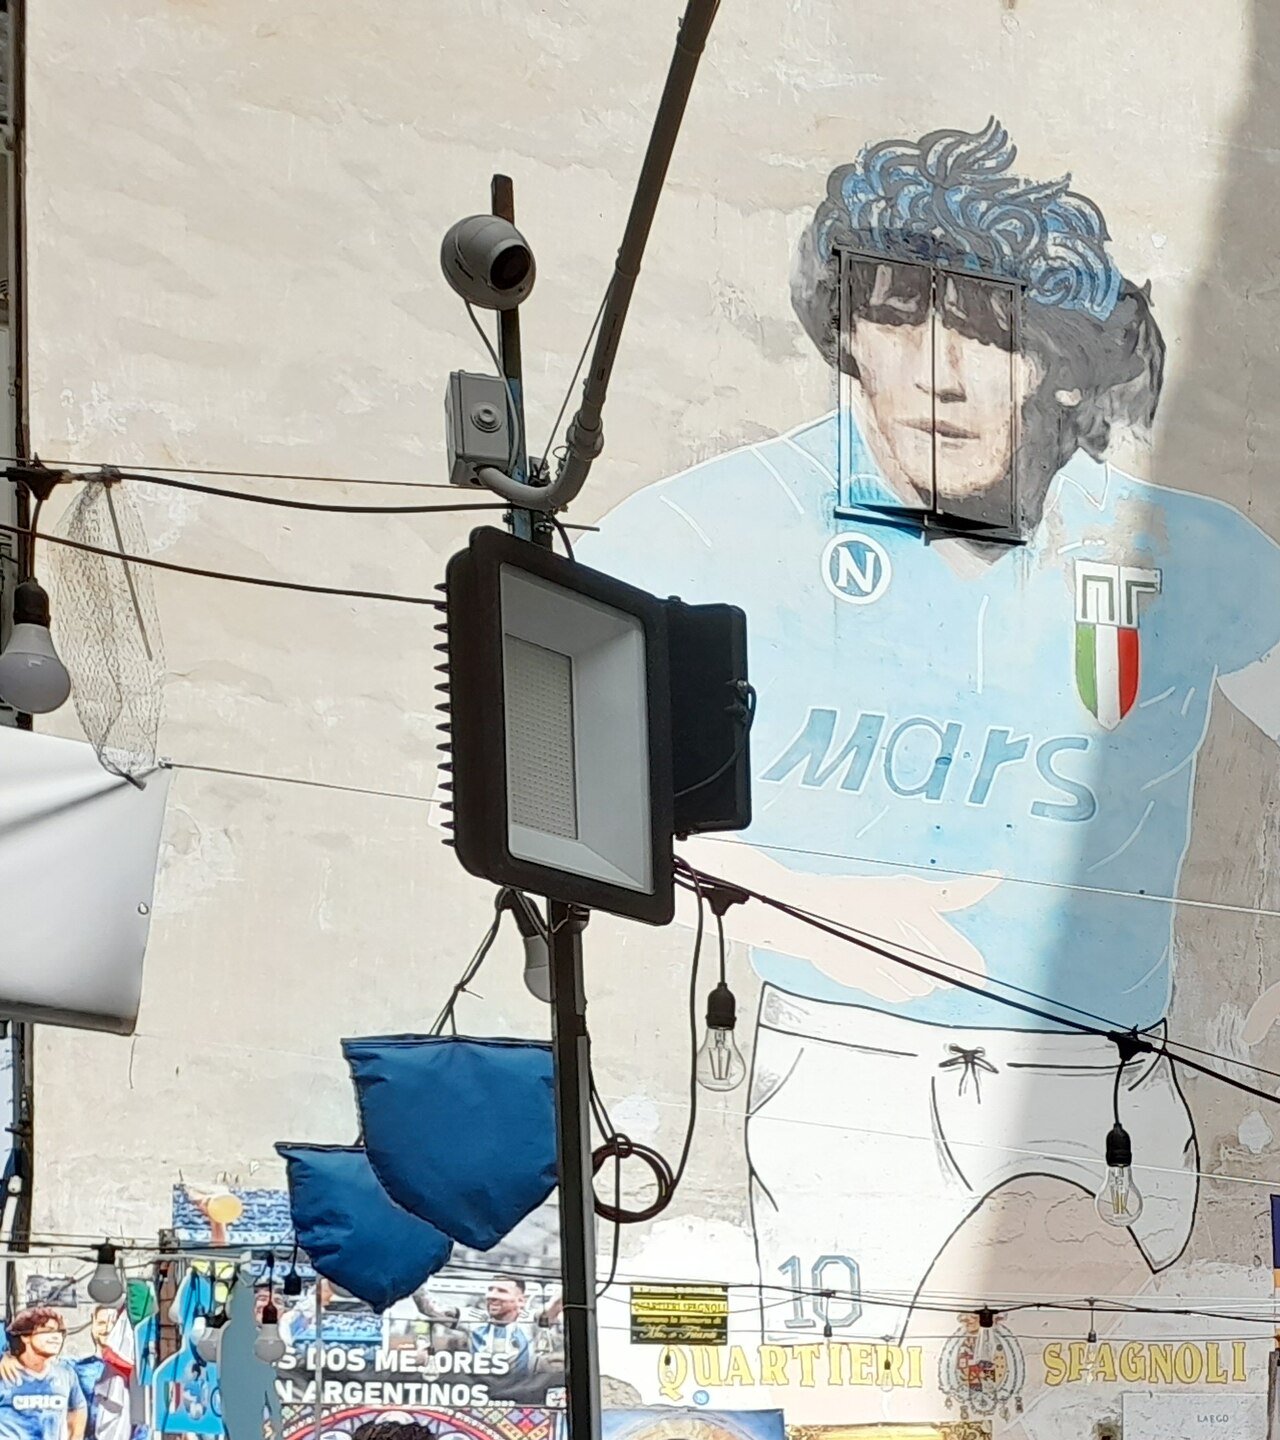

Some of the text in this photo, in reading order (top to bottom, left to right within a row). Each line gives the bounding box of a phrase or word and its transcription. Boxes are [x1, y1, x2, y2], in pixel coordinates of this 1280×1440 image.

[837, 550, 877, 592] N
[759, 707, 1097, 822] Mars
[778, 1255, 861, 1328] 10
[657, 1341, 1248, 1400] QUARTIERI SPAGNOLI
